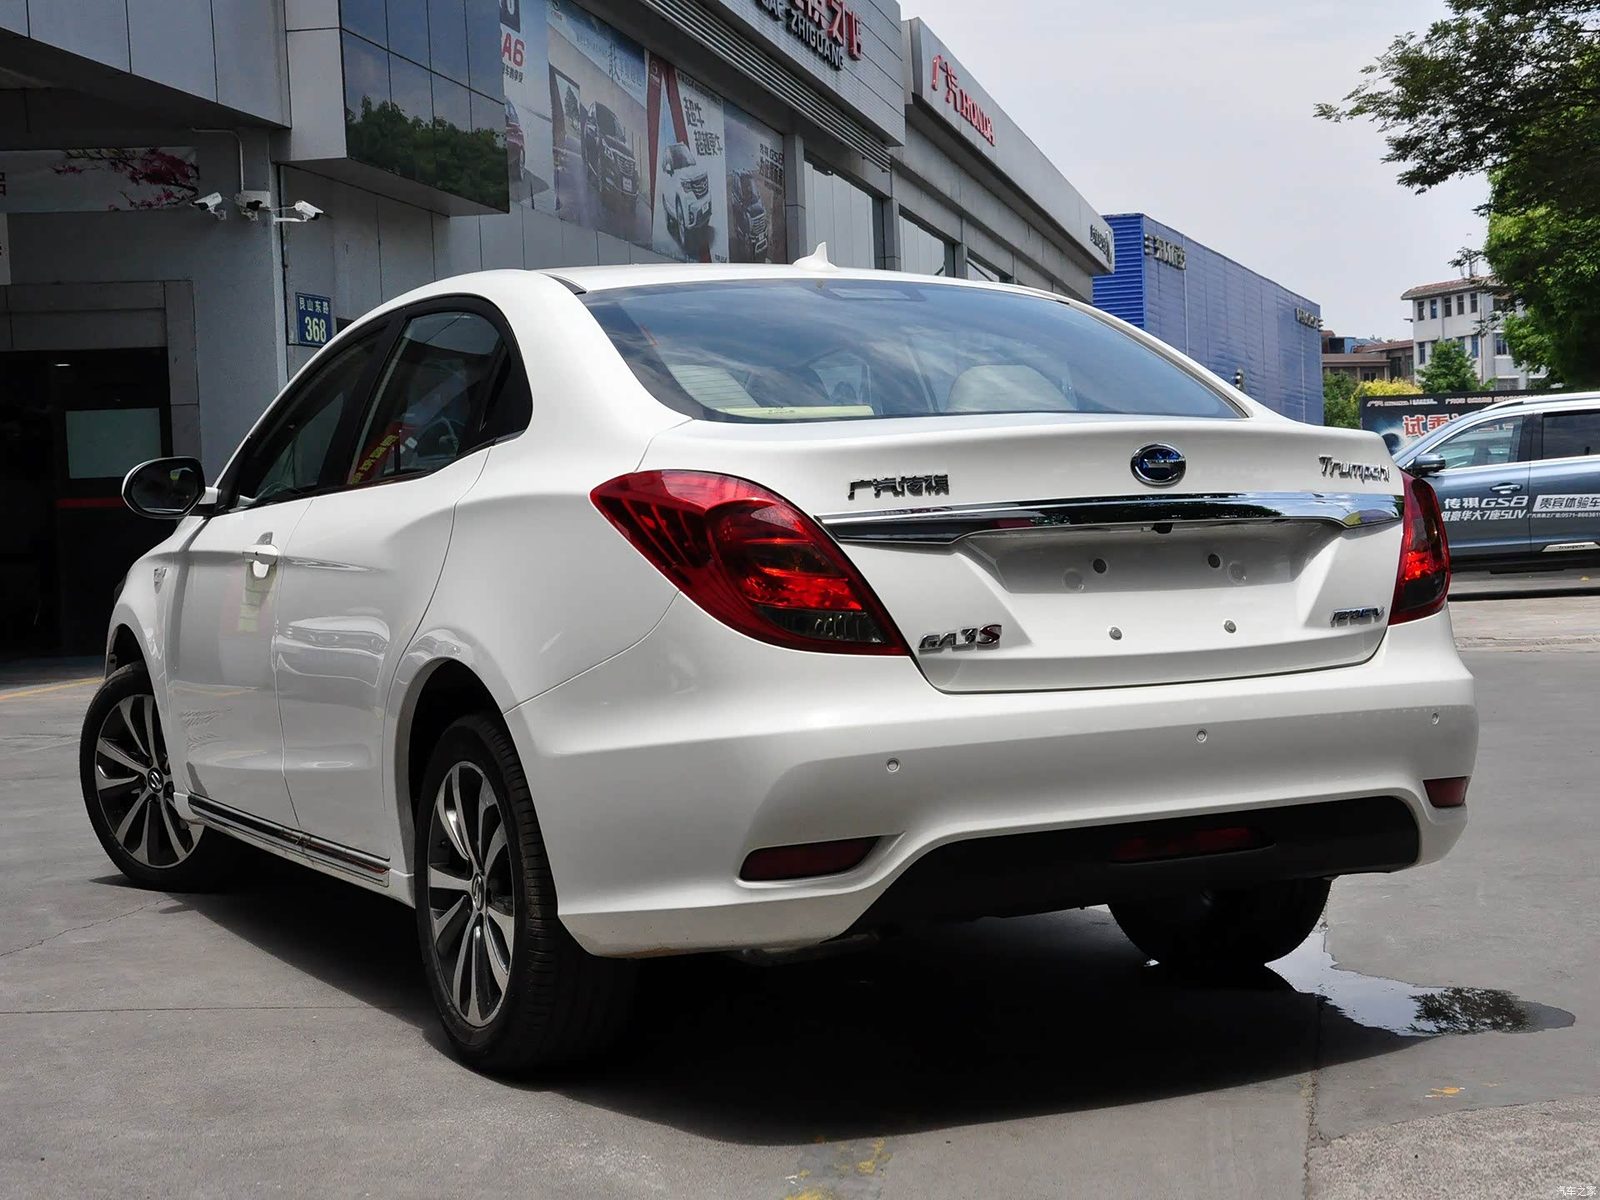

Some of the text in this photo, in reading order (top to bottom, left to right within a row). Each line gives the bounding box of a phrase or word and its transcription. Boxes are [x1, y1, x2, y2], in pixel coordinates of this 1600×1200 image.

[305, 316, 327, 342] 368
[847, 474, 950, 501] 广汽传祺
[919, 624, 1002, 655] GA3S
